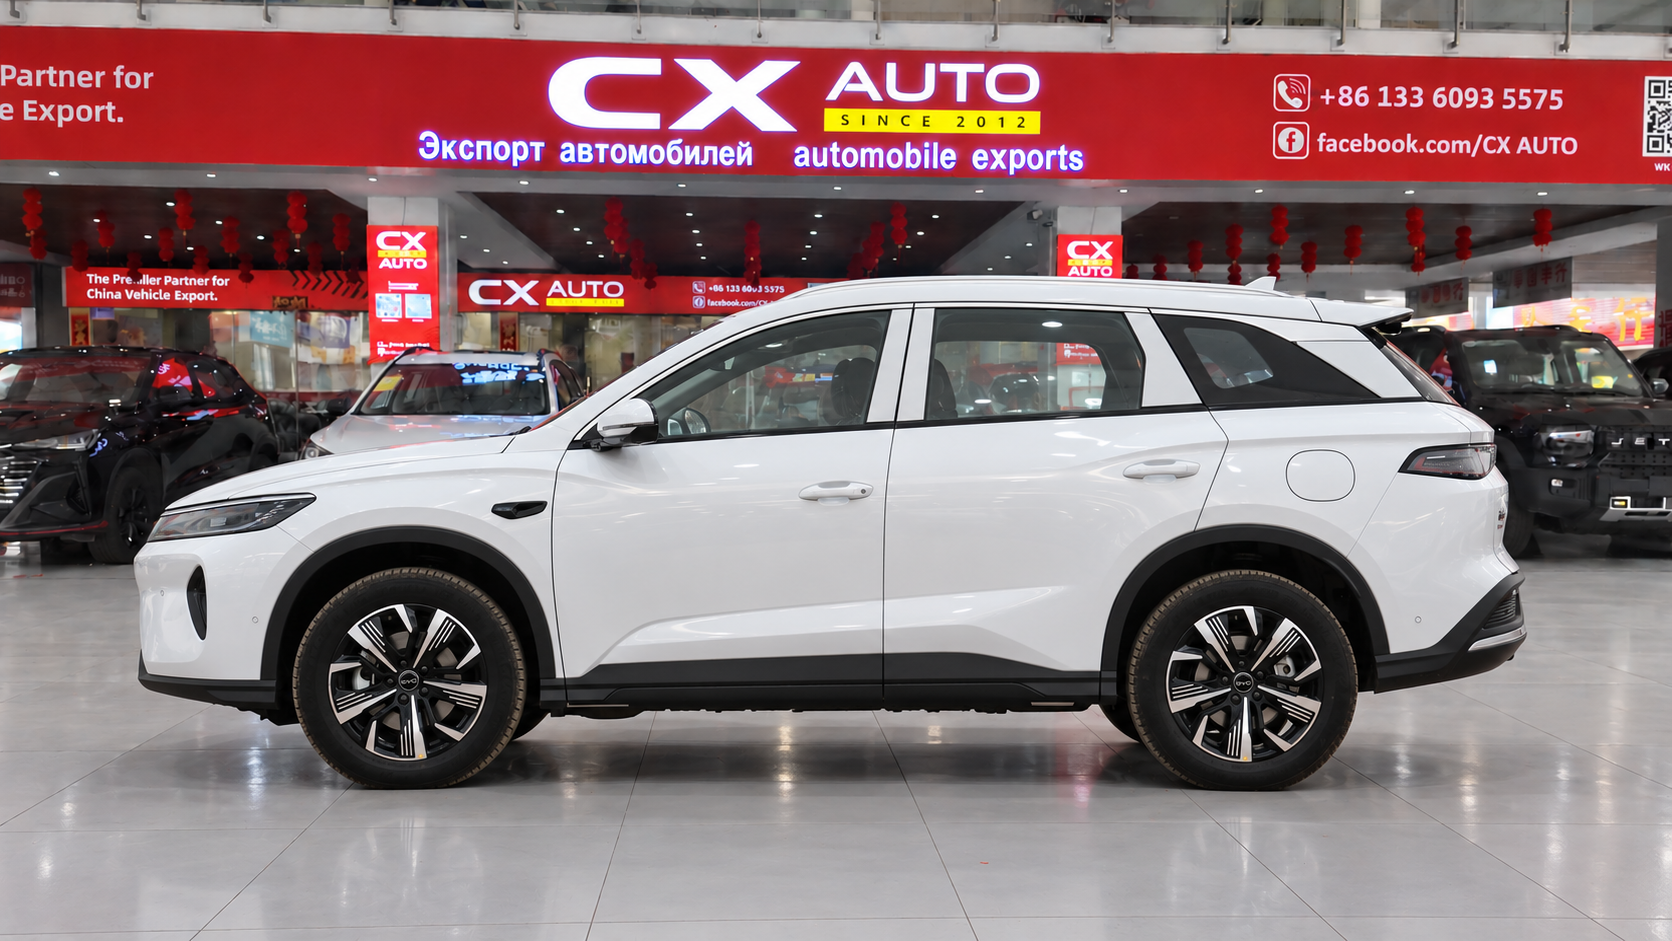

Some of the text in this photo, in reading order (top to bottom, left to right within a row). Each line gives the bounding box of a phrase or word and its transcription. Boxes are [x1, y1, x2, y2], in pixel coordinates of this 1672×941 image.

[0, 65, 154, 89] Partner for
[548, 56, 1040, 132] CX AUTO
[1320, 86, 1564, 110] +86 133 6093 5575
[23, 100, 124, 128] Export.
[840, 113, 1026, 129] SINCE 2012
[418, 130, 752, 167] Экспорт автомобилей
[1317, 133, 1578, 158] facebook.com/CX AUTO
[794, 141, 1084, 176] automobile exports
[376, 231, 426, 251] CX
[1067, 240, 1114, 260] CX
[378, 258, 428, 269] AUTO
[1068, 266, 1113, 277] AUTO
[86, 273, 110, 285] The
[164, 275, 209, 286] Partner
[212, 275, 230, 287] for
[726, 284, 740, 293] 133
[86, 287, 218, 303] China Vehicle Export.
[468, 279, 624, 306] CX AUTO
